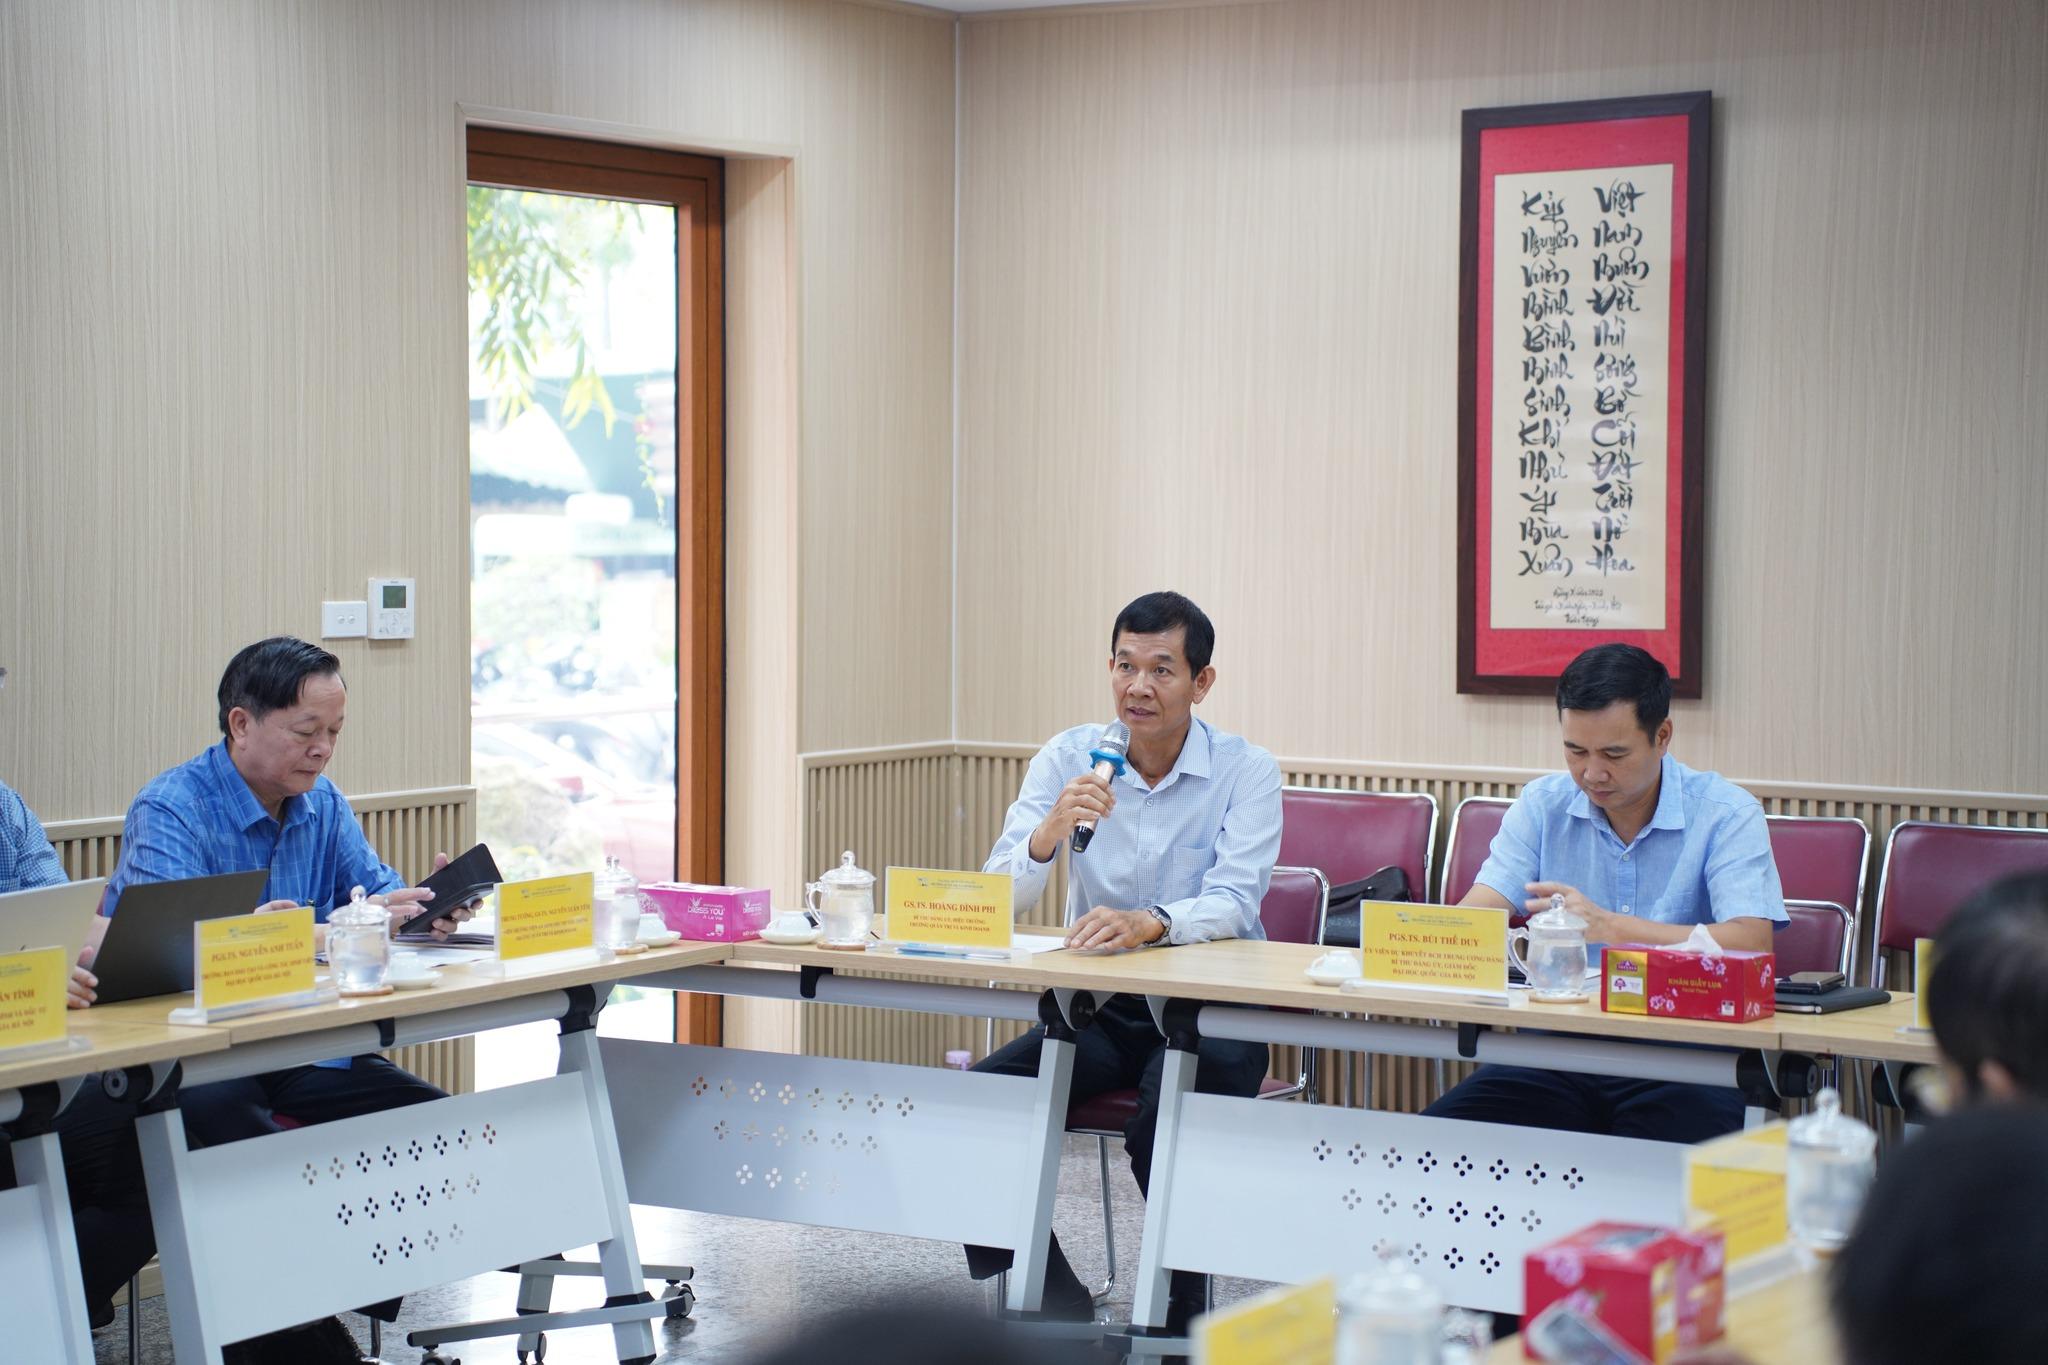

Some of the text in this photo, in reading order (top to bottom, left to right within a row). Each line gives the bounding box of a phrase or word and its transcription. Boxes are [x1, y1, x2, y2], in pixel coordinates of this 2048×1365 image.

[1592, 177, 1646, 218] Việt
[981, 904, 997, 914] PHI
[1460, 937, 1480, 948] DUY
